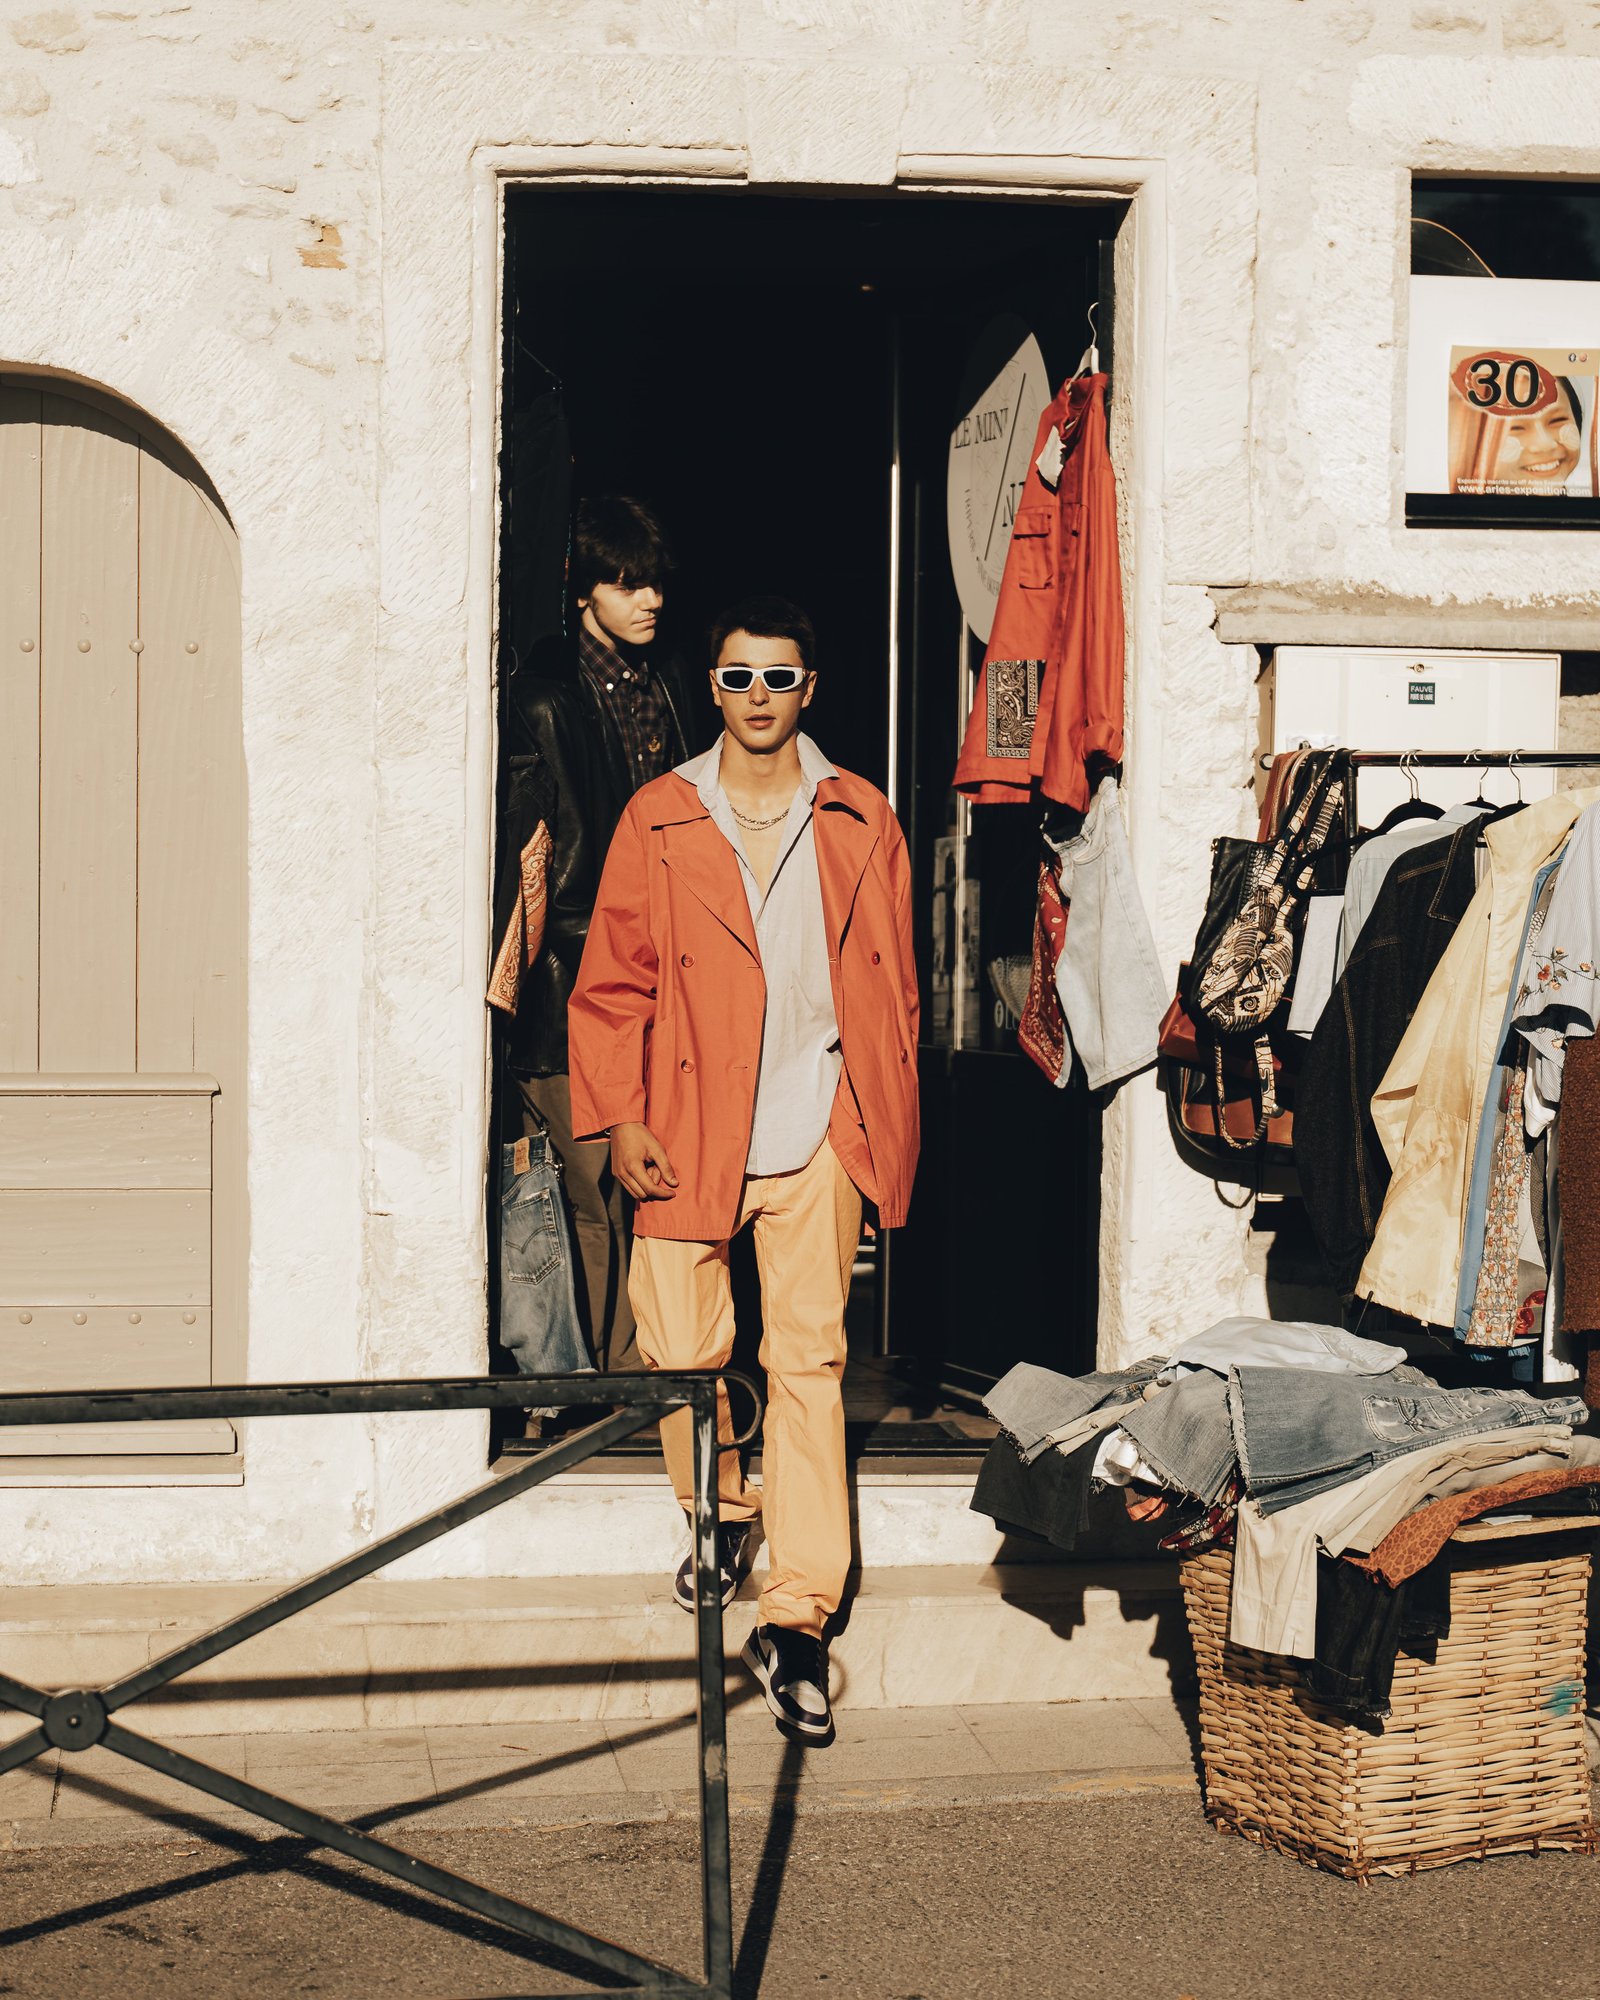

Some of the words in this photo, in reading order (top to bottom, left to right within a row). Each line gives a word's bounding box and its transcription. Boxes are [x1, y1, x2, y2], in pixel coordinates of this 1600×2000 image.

[1467, 358, 1540, 408] 30
[954, 417, 970, 449] LE
[1457, 485, 1591, 496] www.arles-exposition.com
[1410, 685, 1433, 693] FAUVE
